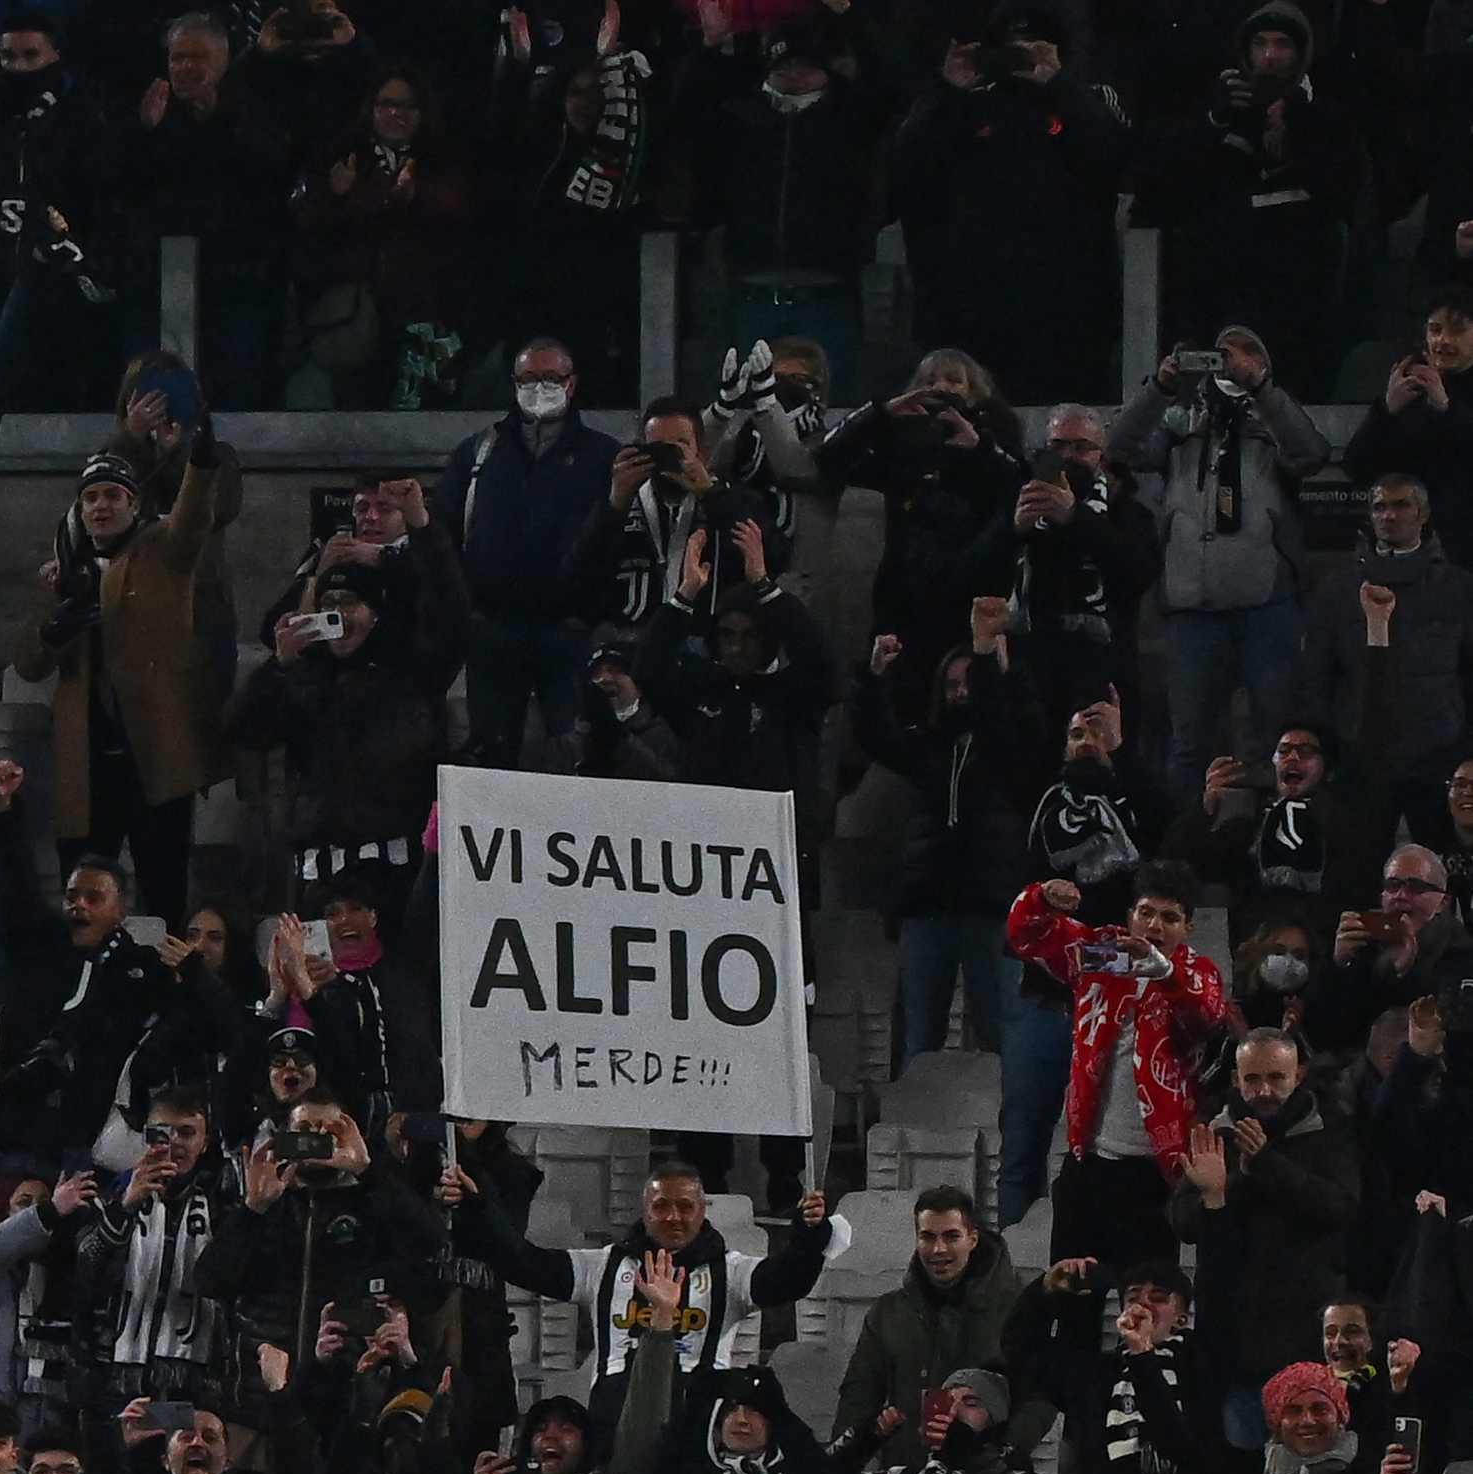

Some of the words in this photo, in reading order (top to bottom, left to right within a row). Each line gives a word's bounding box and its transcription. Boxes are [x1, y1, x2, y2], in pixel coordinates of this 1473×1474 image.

[459, 824, 523, 884] VI
[546, 831, 786, 905] SALUTA
[469, 917, 778, 1027] ALFIO
[520, 1039, 731, 1097] MERDE!!!
